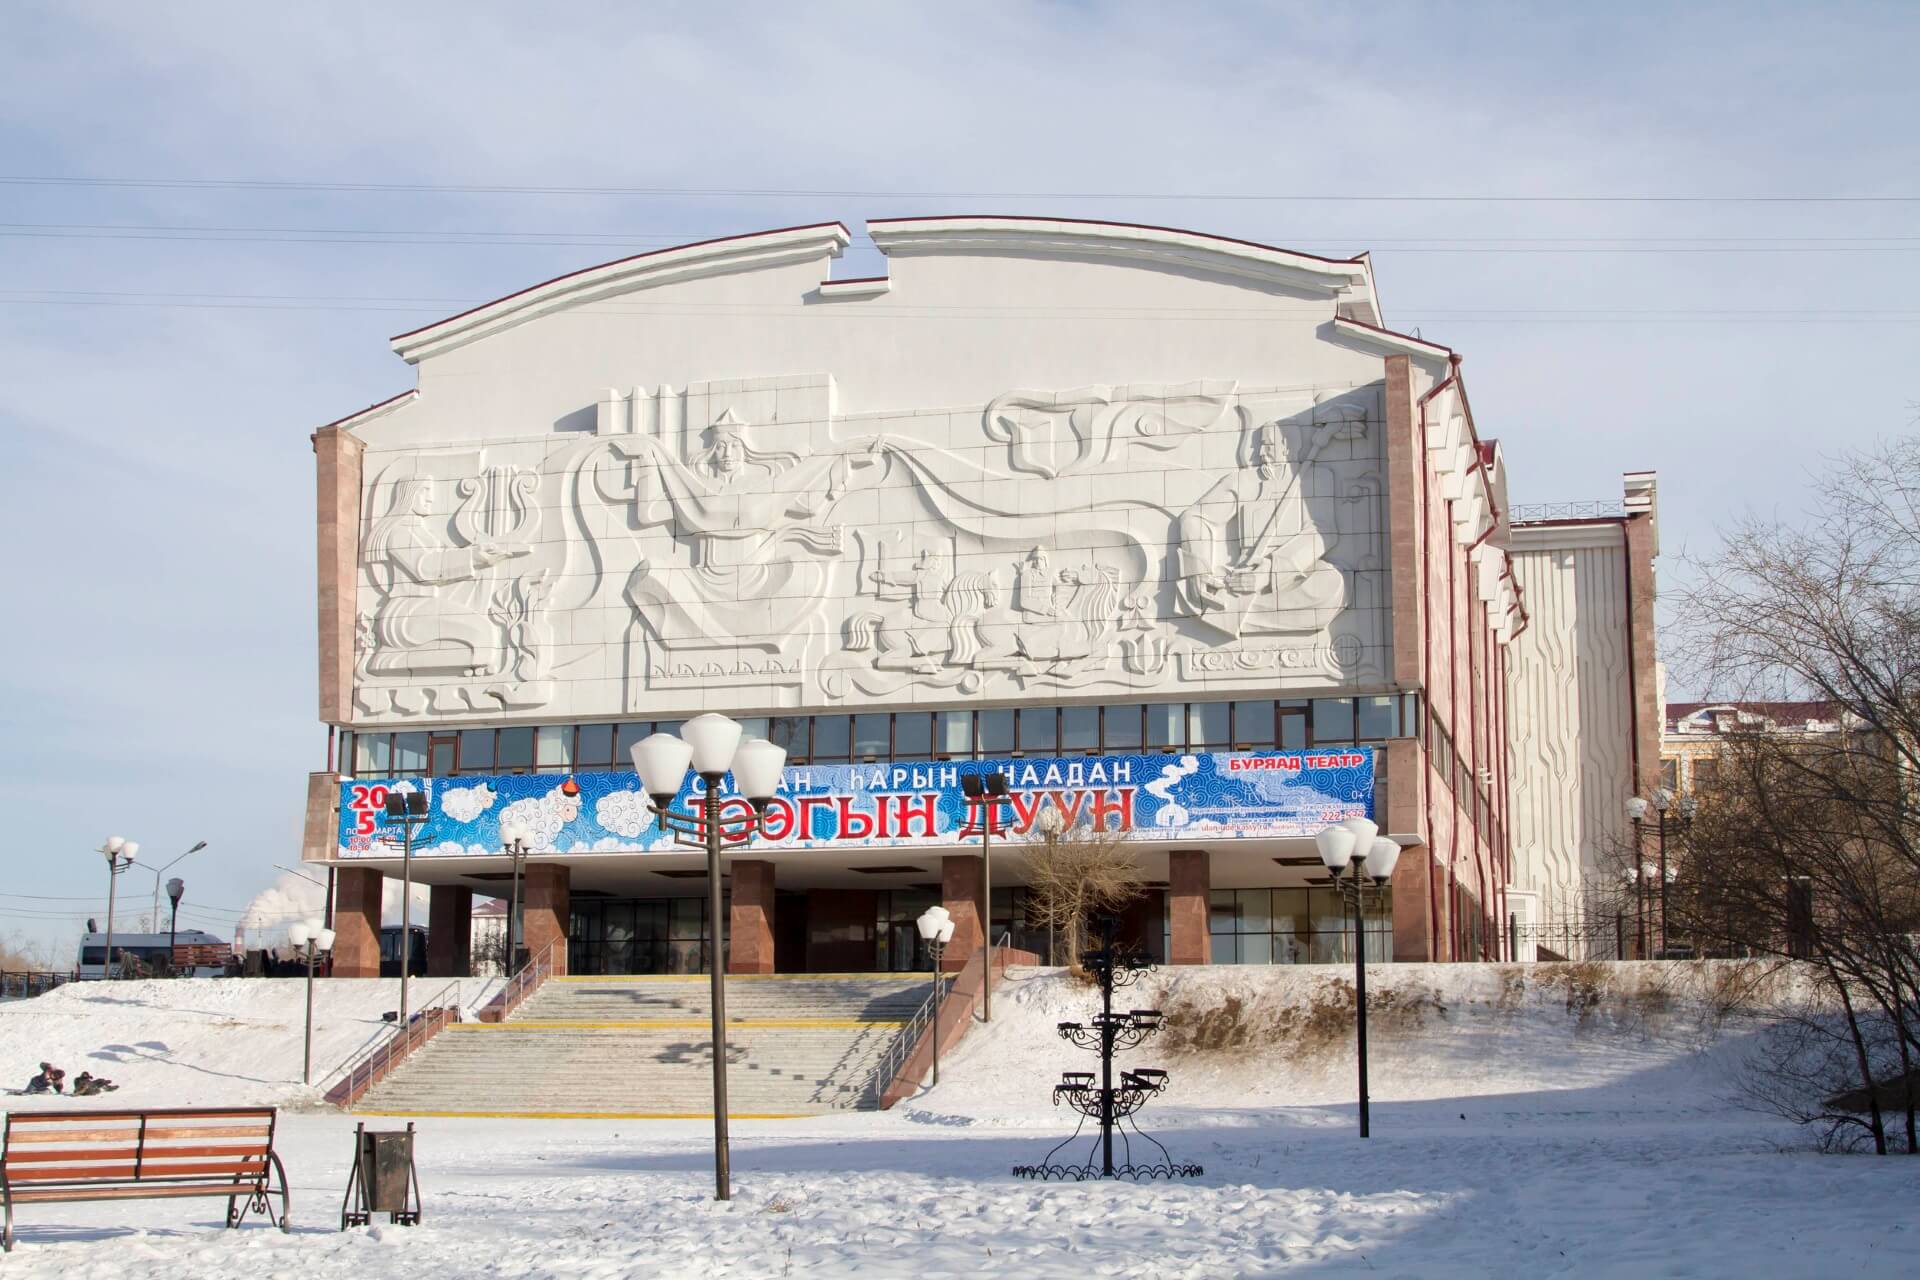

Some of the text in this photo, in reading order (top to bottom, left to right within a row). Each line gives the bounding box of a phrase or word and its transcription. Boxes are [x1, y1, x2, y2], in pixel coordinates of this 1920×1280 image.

[1230, 754, 1364, 771] БУРЯАД ТЕАТР
[692, 772, 811, 795] СААН
[998, 761, 1131, 788] НААДАН
[352, 785, 390, 809] 20
[1351, 790, 1364, 800] 0+
[959, 788, 1136, 841] ДУУН
